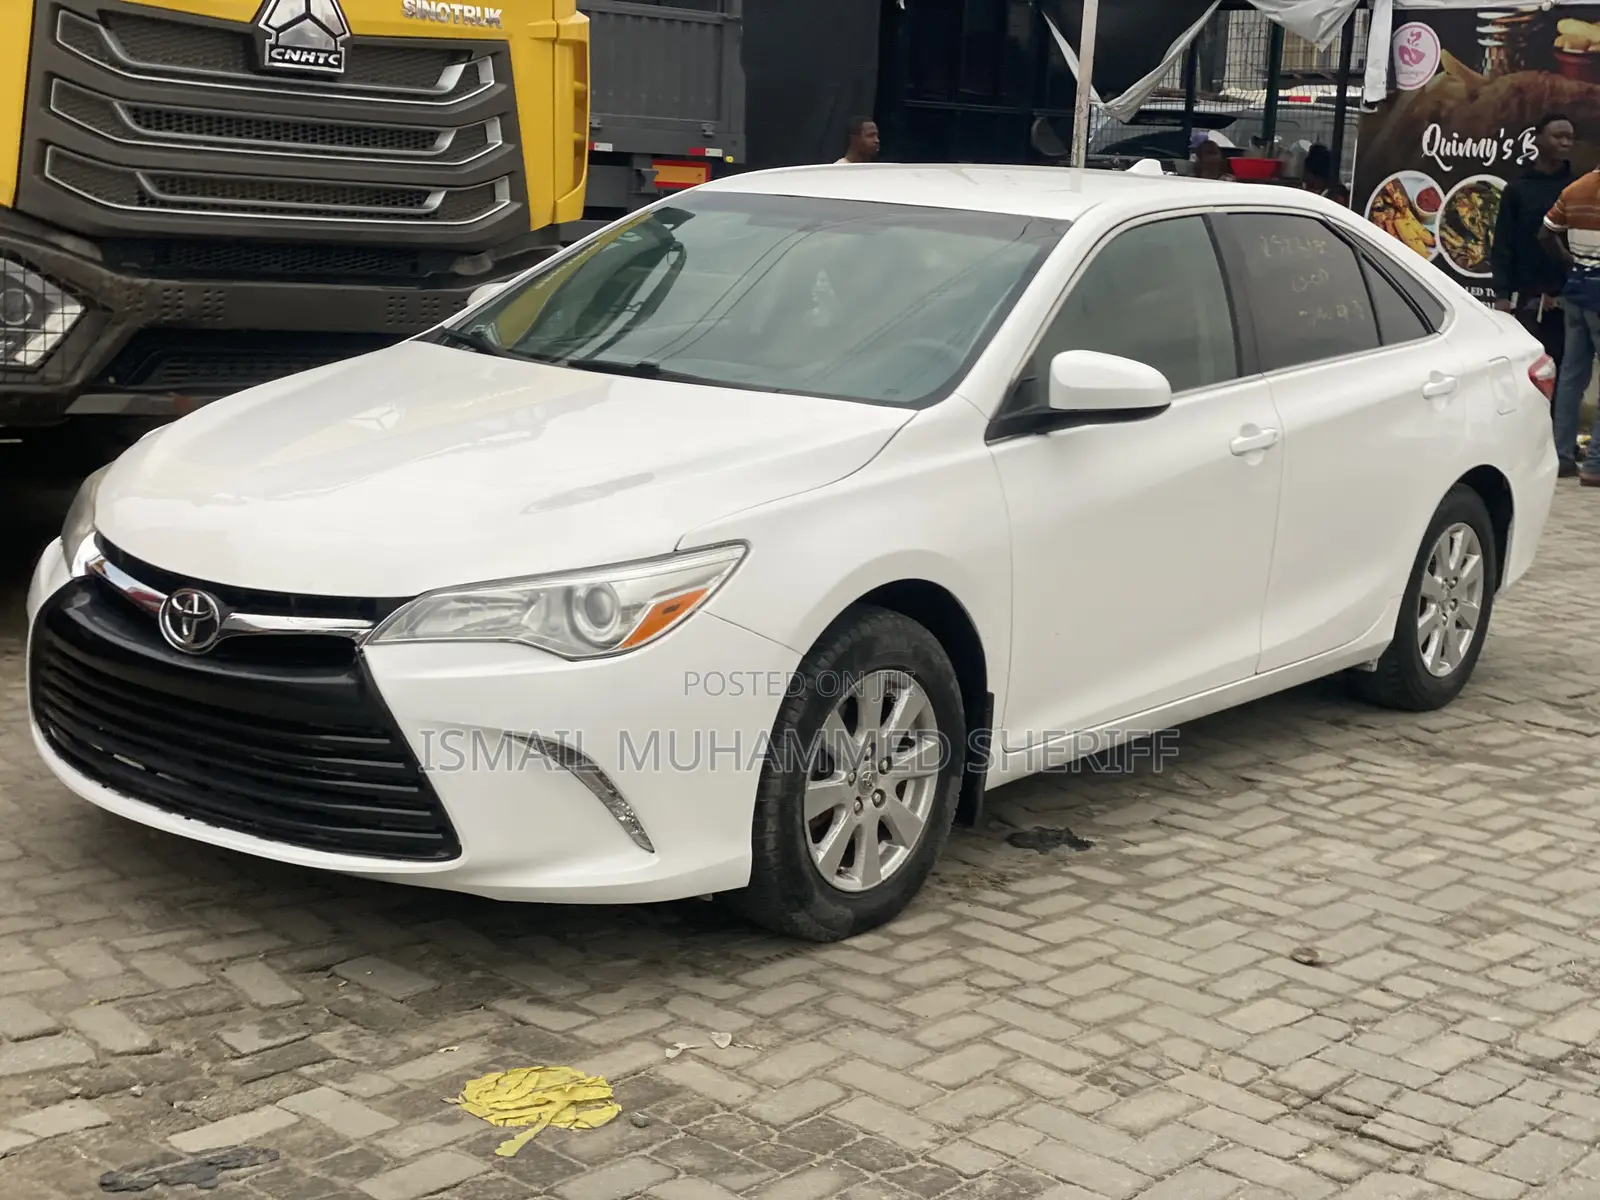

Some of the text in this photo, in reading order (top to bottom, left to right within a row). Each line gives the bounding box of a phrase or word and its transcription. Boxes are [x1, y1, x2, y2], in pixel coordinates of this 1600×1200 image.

[402, 0, 503, 28] SINOTRUK
[270, 48, 340, 65] CNHTC
[1421, 123, 1514, 172] Quinny's
